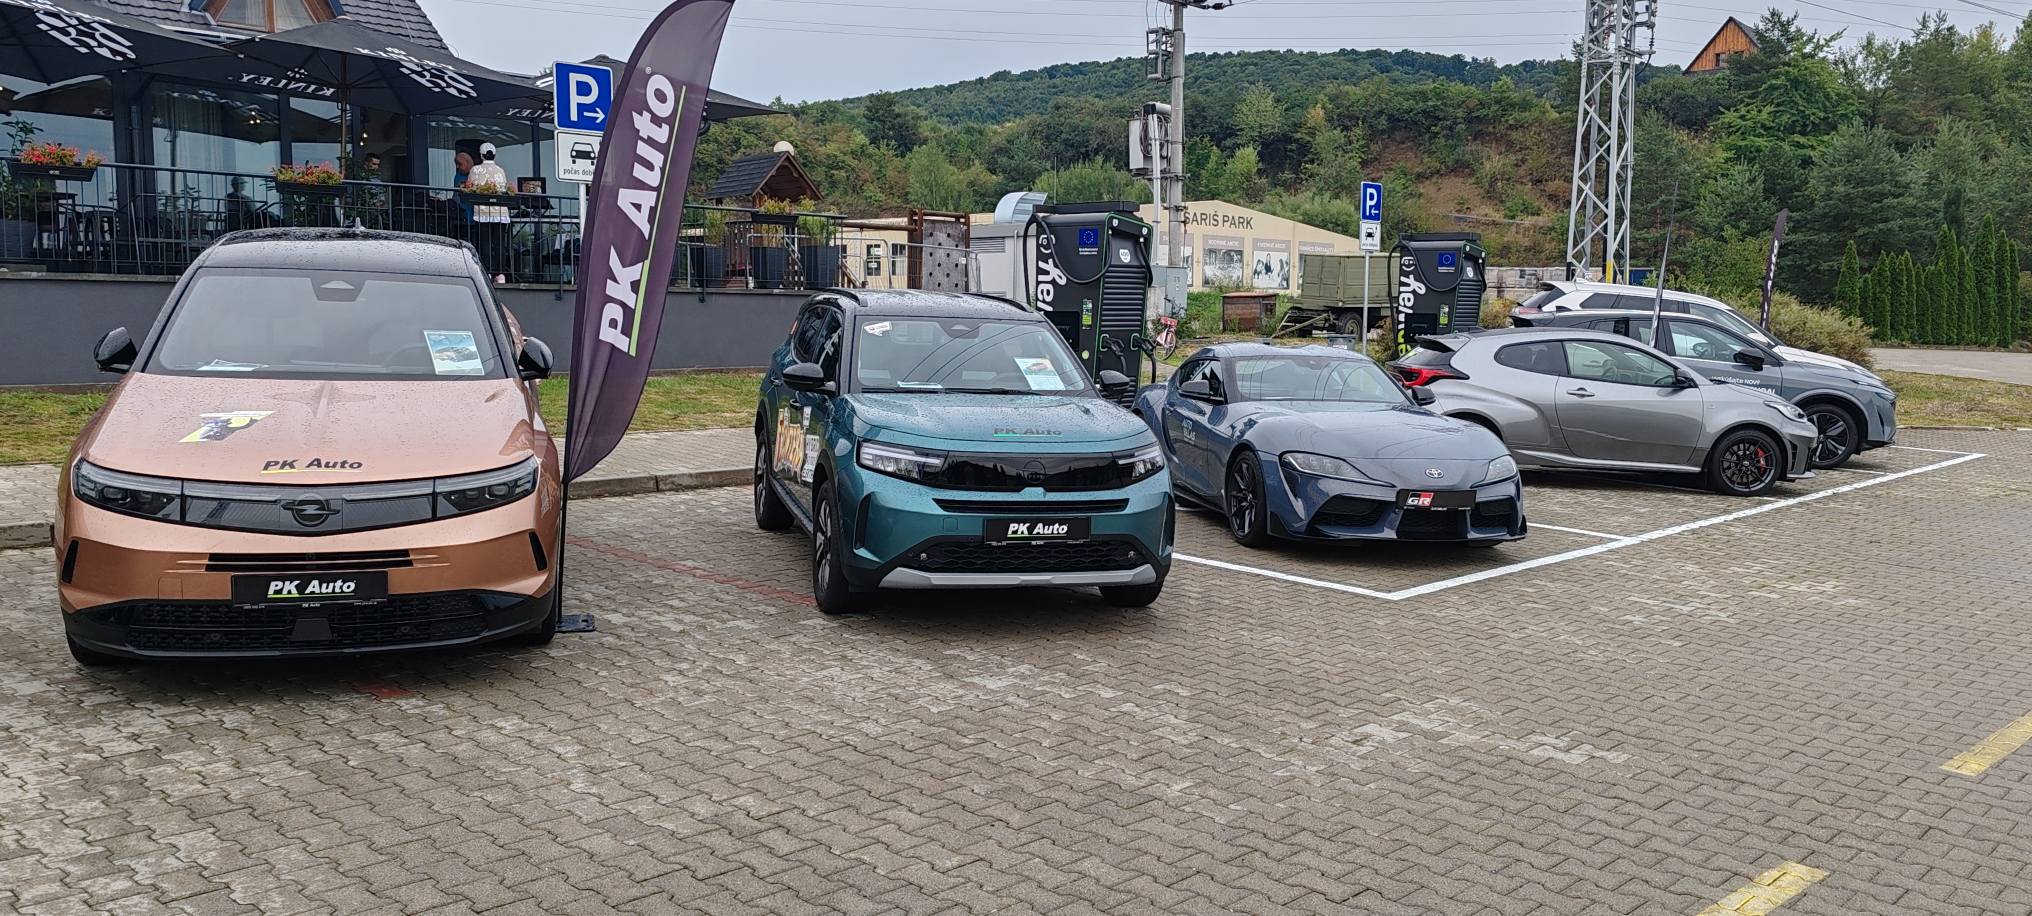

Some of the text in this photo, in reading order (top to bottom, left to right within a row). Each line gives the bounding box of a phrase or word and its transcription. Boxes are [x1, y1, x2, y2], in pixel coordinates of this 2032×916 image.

[569, 72, 599, 122] P
[563, 167, 595, 177] počas dob
[1366, 187, 1378, 217] P
[599, 73, 675, 353] PK Auto
[1222, 214, 1254, 230] PARK
[993, 427, 1062, 435] PK Auto
[262, 457, 363, 471] PK Auto
[1407, 497, 1432, 505] GR
[1007, 522, 1068, 535] PK Auto
[267, 579, 356, 595] PK Auto
